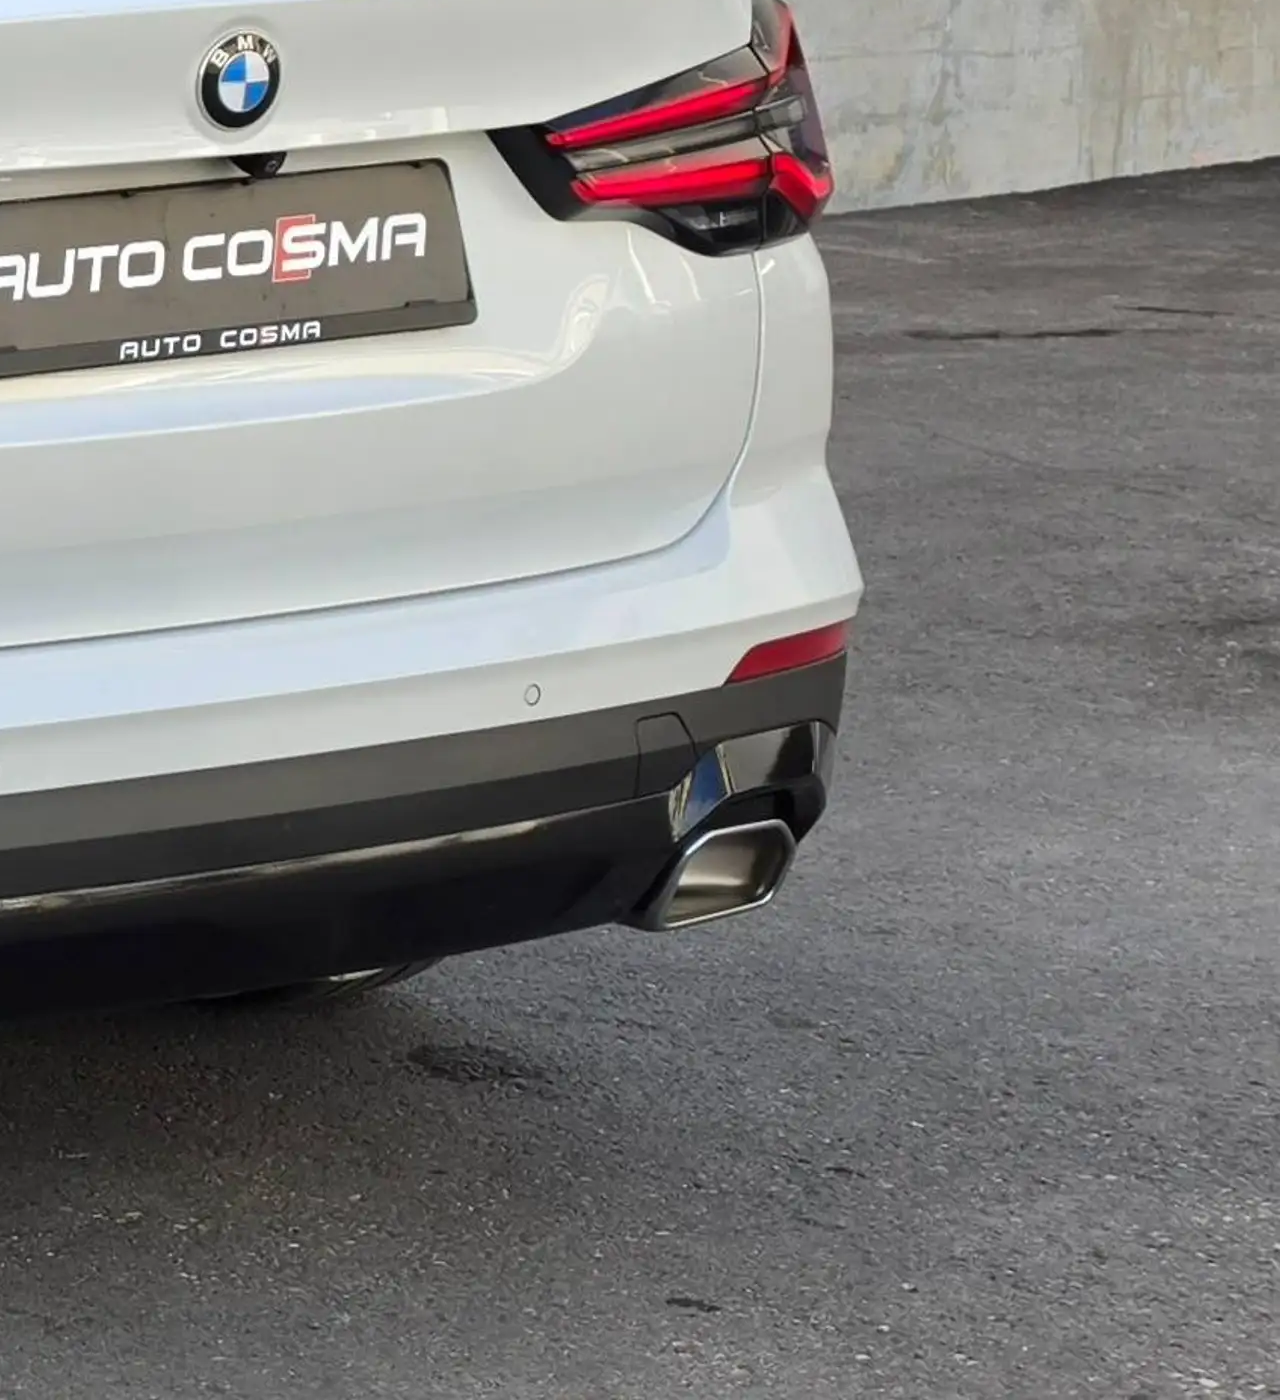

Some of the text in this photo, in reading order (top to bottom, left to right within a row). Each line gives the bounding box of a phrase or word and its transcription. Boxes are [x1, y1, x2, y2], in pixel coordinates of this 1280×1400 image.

[210, 34, 277, 68] BMW
[182, 212, 427, 282] COSMA
[119, 320, 321, 361] AUTO COSMA
